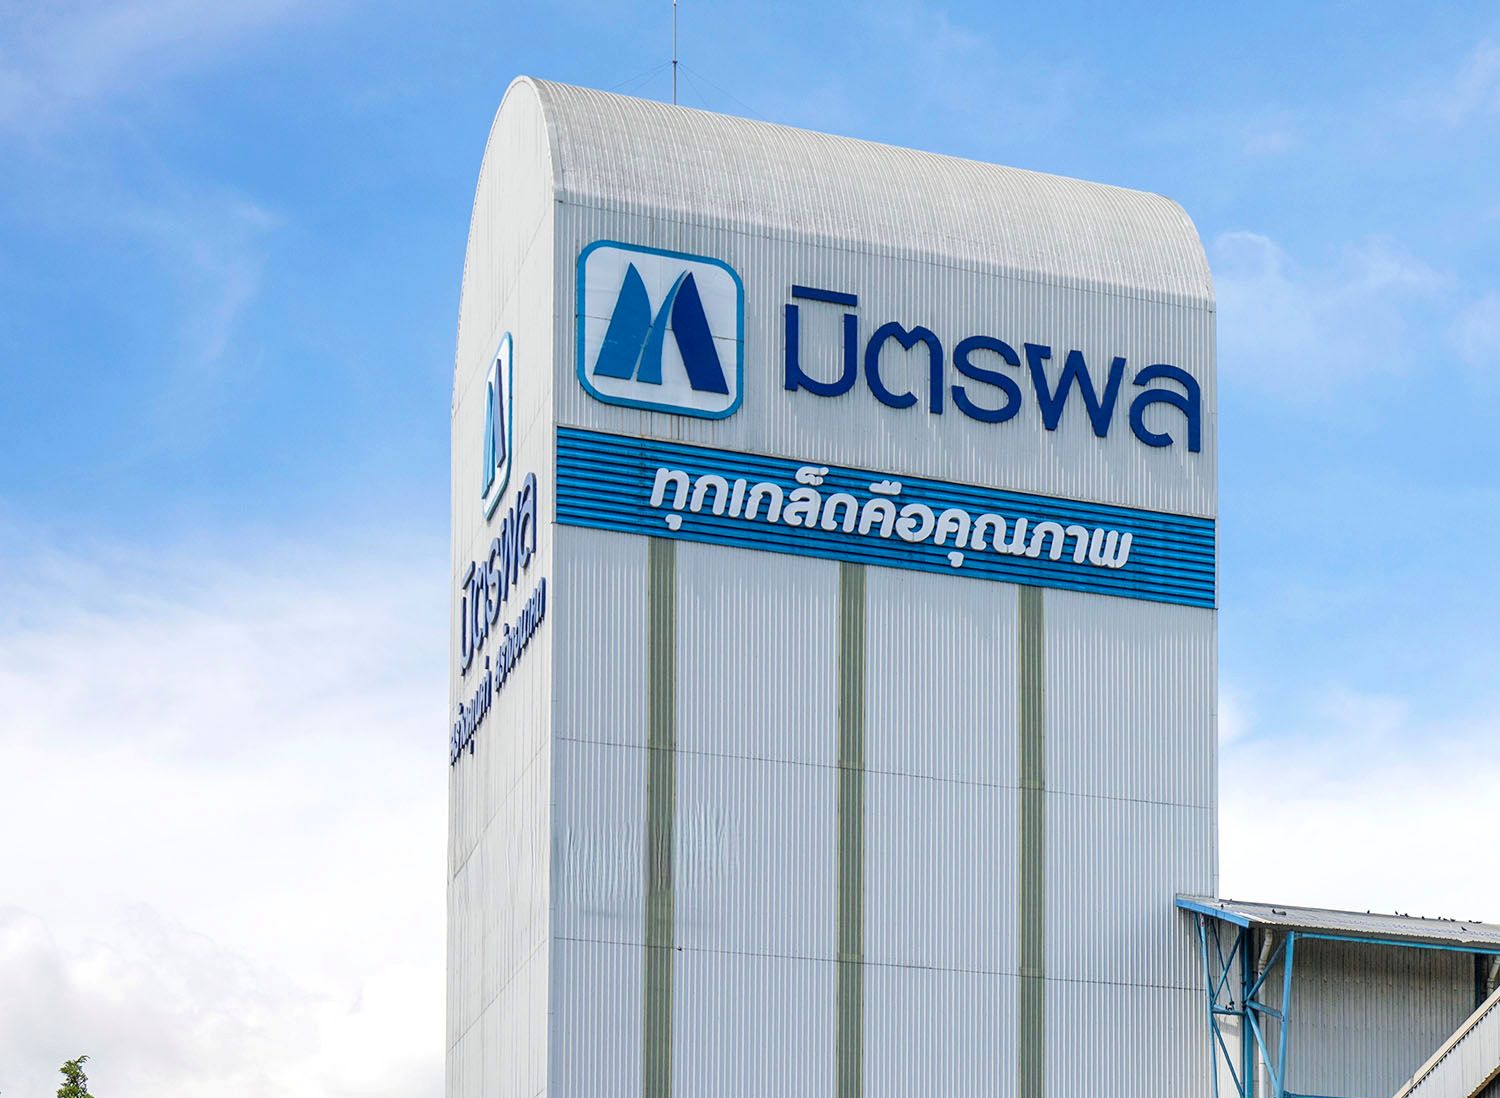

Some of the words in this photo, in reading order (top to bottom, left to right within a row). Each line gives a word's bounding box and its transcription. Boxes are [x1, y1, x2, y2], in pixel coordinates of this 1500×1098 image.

[785, 285, 1201, 452] มิตรผล
[650, 467, 1133, 569] ทุกเกล็ดคือคุณภาพ
